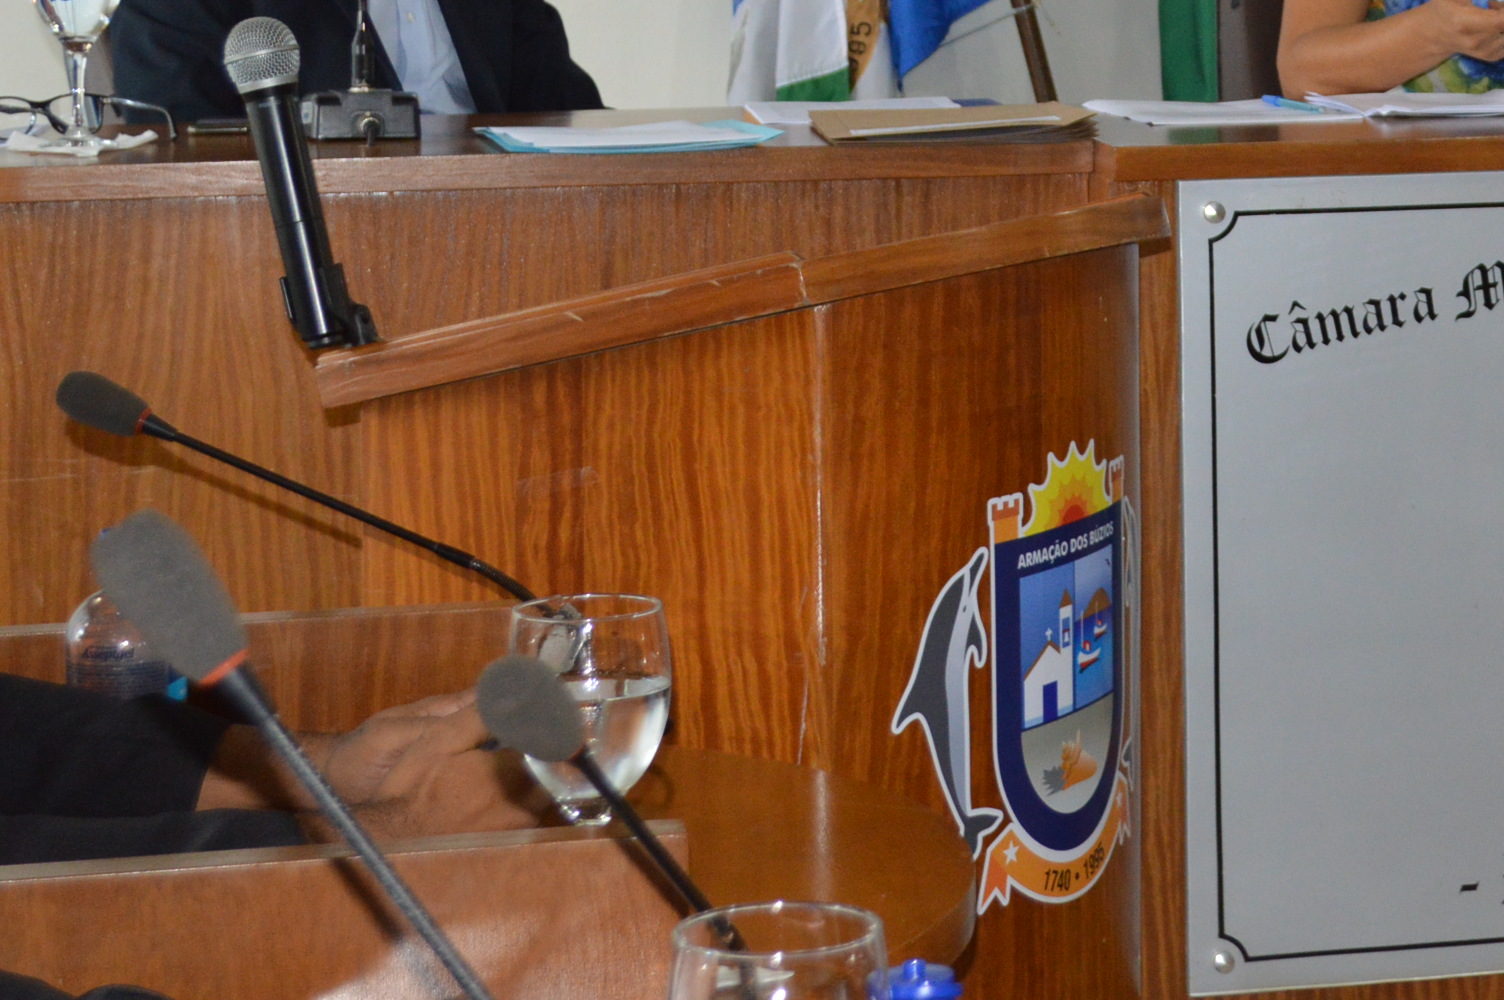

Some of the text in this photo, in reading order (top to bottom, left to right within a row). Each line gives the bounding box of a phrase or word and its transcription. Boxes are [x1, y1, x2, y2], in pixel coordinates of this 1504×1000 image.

[1246, 283, 1438, 365] Câmara
[1017, 539, 1069, 569] ARMAÇÃO
[1070, 533, 1089, 553] DOS
[1045, 842, 1105, 892] 1740 1995
